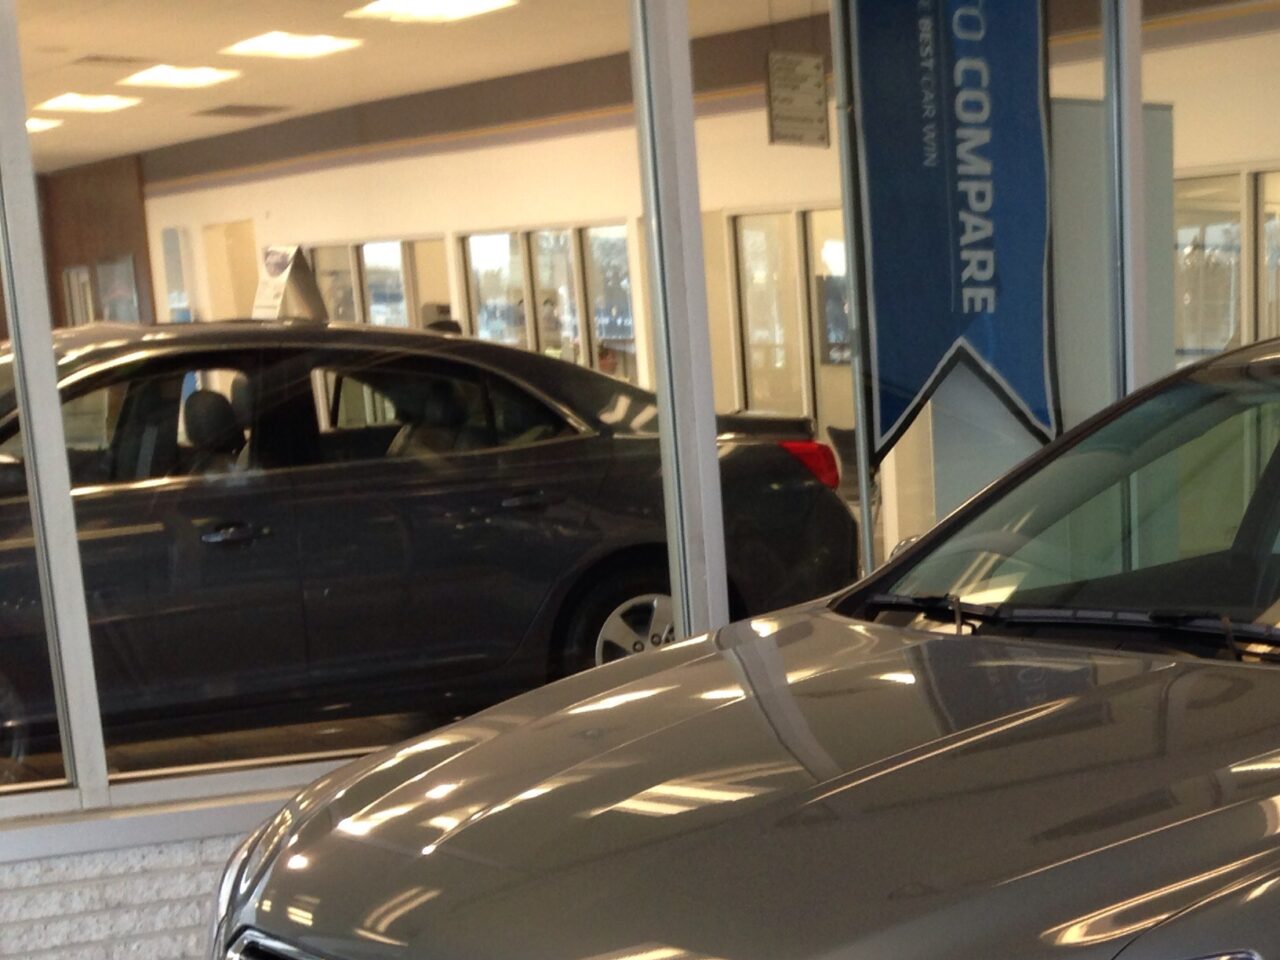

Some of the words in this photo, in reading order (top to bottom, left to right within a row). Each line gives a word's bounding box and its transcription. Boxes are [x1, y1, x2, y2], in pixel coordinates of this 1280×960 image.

[952, 0, 986, 41] O
[918, 17, 934, 71] BEST
[921, 75, 936, 119] CAR
[922, 122, 937, 168] WIN
[953, 57, 996, 314] COMPARE
